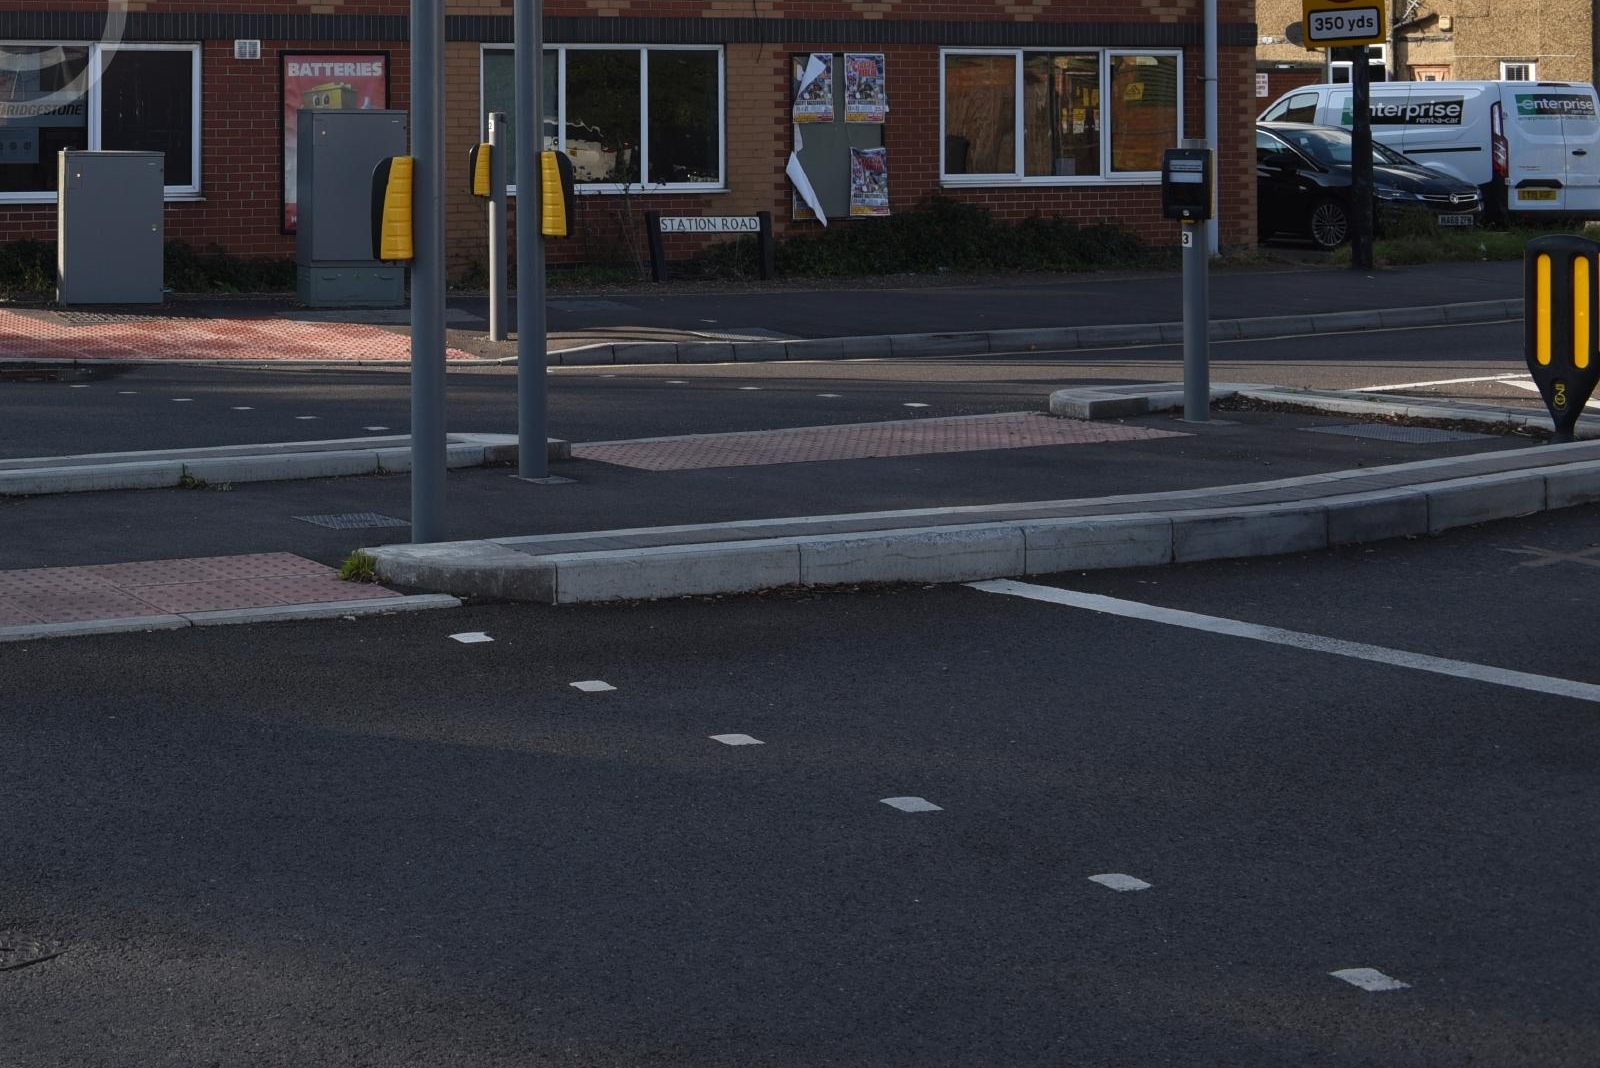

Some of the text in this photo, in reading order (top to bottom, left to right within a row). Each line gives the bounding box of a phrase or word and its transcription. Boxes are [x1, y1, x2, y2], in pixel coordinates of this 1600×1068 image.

[1314, 15, 1374, 32] 350 yds
[288, 62, 382, 77] BATTERIES
[1349, 100, 1461, 121] nterprise
[1522, 98, 1594, 112] enterprise
[1416, 115, 1460, 124] rent-a-car
[661, 218, 758, 231] STATION ROAD
[1182, 233, 1189, 244] 3
